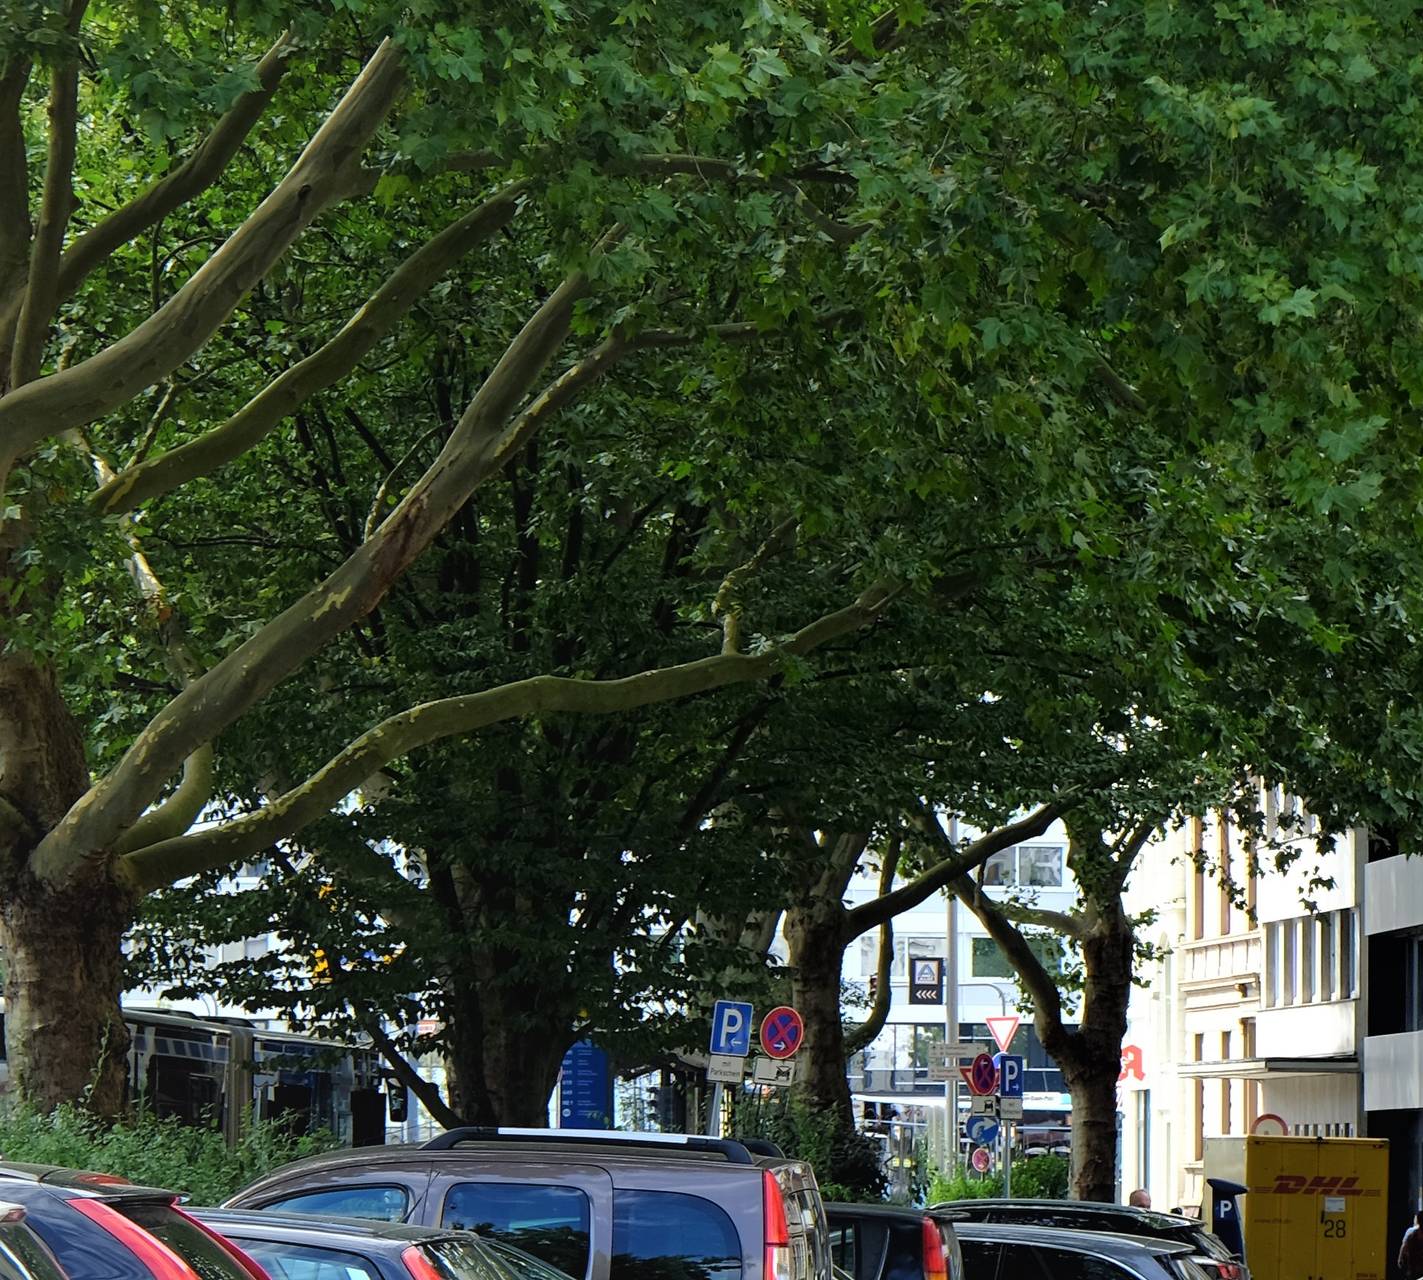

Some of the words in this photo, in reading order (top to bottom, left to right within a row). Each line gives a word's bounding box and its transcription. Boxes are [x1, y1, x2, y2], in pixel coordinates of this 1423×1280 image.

[720, 1008, 743, 1047] P
[1005, 1060, 1018, 1092] P
[1272, 1175, 1363, 1196] DHL
[1220, 1200, 1233, 1218] P
[1323, 1219, 1346, 1238] 28
